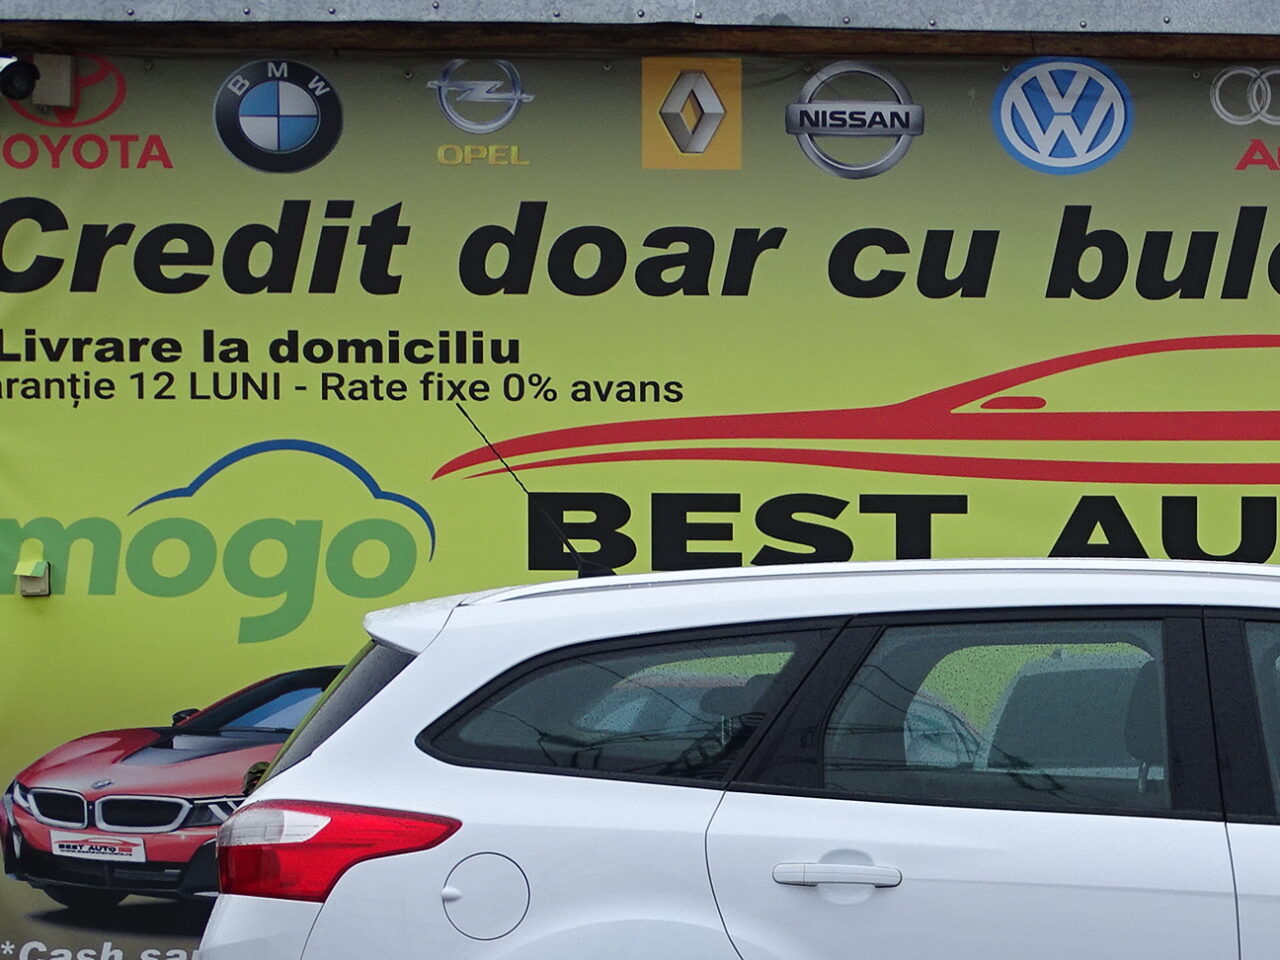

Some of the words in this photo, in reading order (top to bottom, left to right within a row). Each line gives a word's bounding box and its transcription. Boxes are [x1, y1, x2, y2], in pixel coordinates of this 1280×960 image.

[800, 110, 911, 130] NISSAN
[436, 144, 531, 166] OPEL
[0, 197, 410, 295] Credit
[459, 201, 787, 296] doar
[828, 228, 1000, 299] cu
[0, 328, 183, 363] Livrare
[203, 329, 249, 363] la
[268, 329, 520, 364] domiciliu
[0, 371, 116, 409] ranție
[129, 371, 176, 400] 12
[190, 371, 280, 401] LUNI
[321, 372, 408, 402] Rate
[419, 372, 490, 401] fixe
[503, 373, 558, 402] 0%
[570, 380, 684, 403] avans
[528, 492, 968, 572] BEST
[0, 516, 418, 645] mogo
